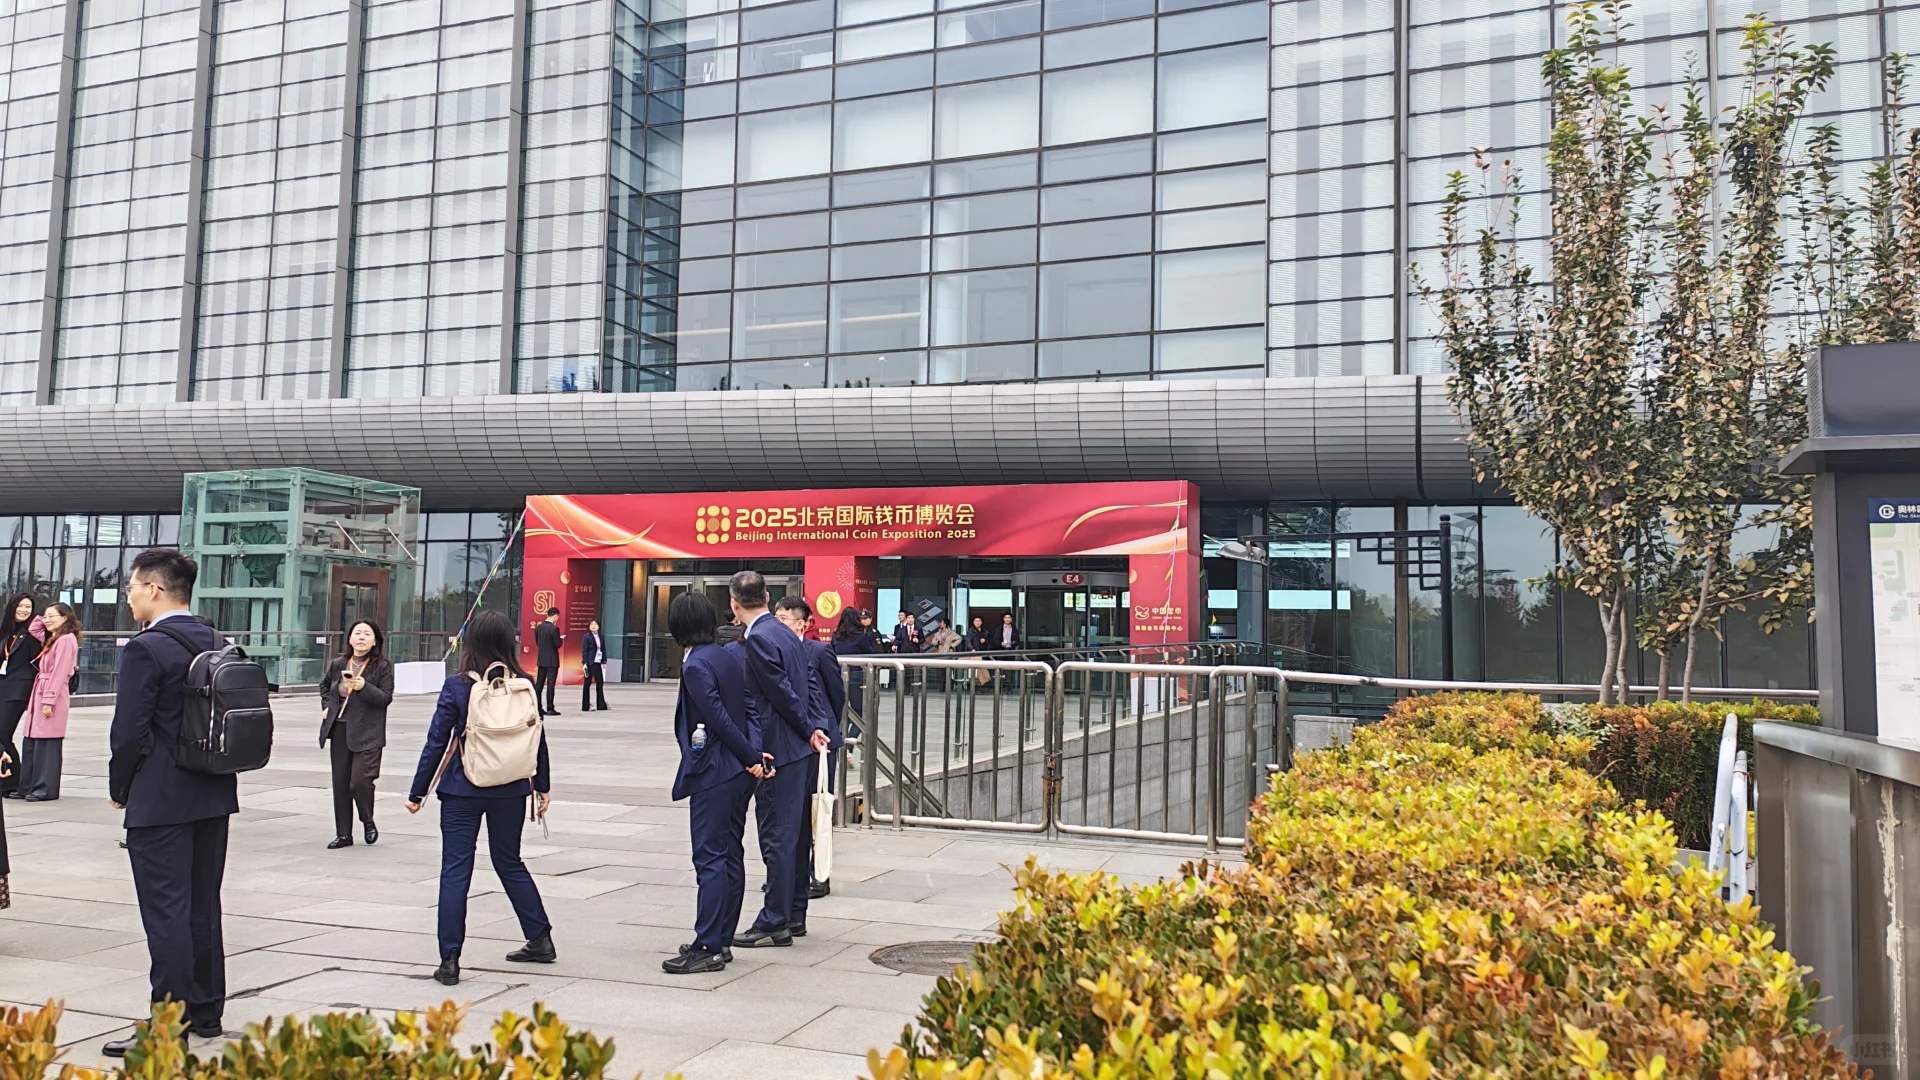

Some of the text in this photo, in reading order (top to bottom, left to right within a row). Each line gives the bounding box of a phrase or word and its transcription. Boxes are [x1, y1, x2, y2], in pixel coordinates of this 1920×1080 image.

[735, 503, 975, 528] 2025北京国际钱币博览会
[735, 528, 976, 543] Beijing International Coin Exposition 2025
[1066, 574, 1080, 583] E4
